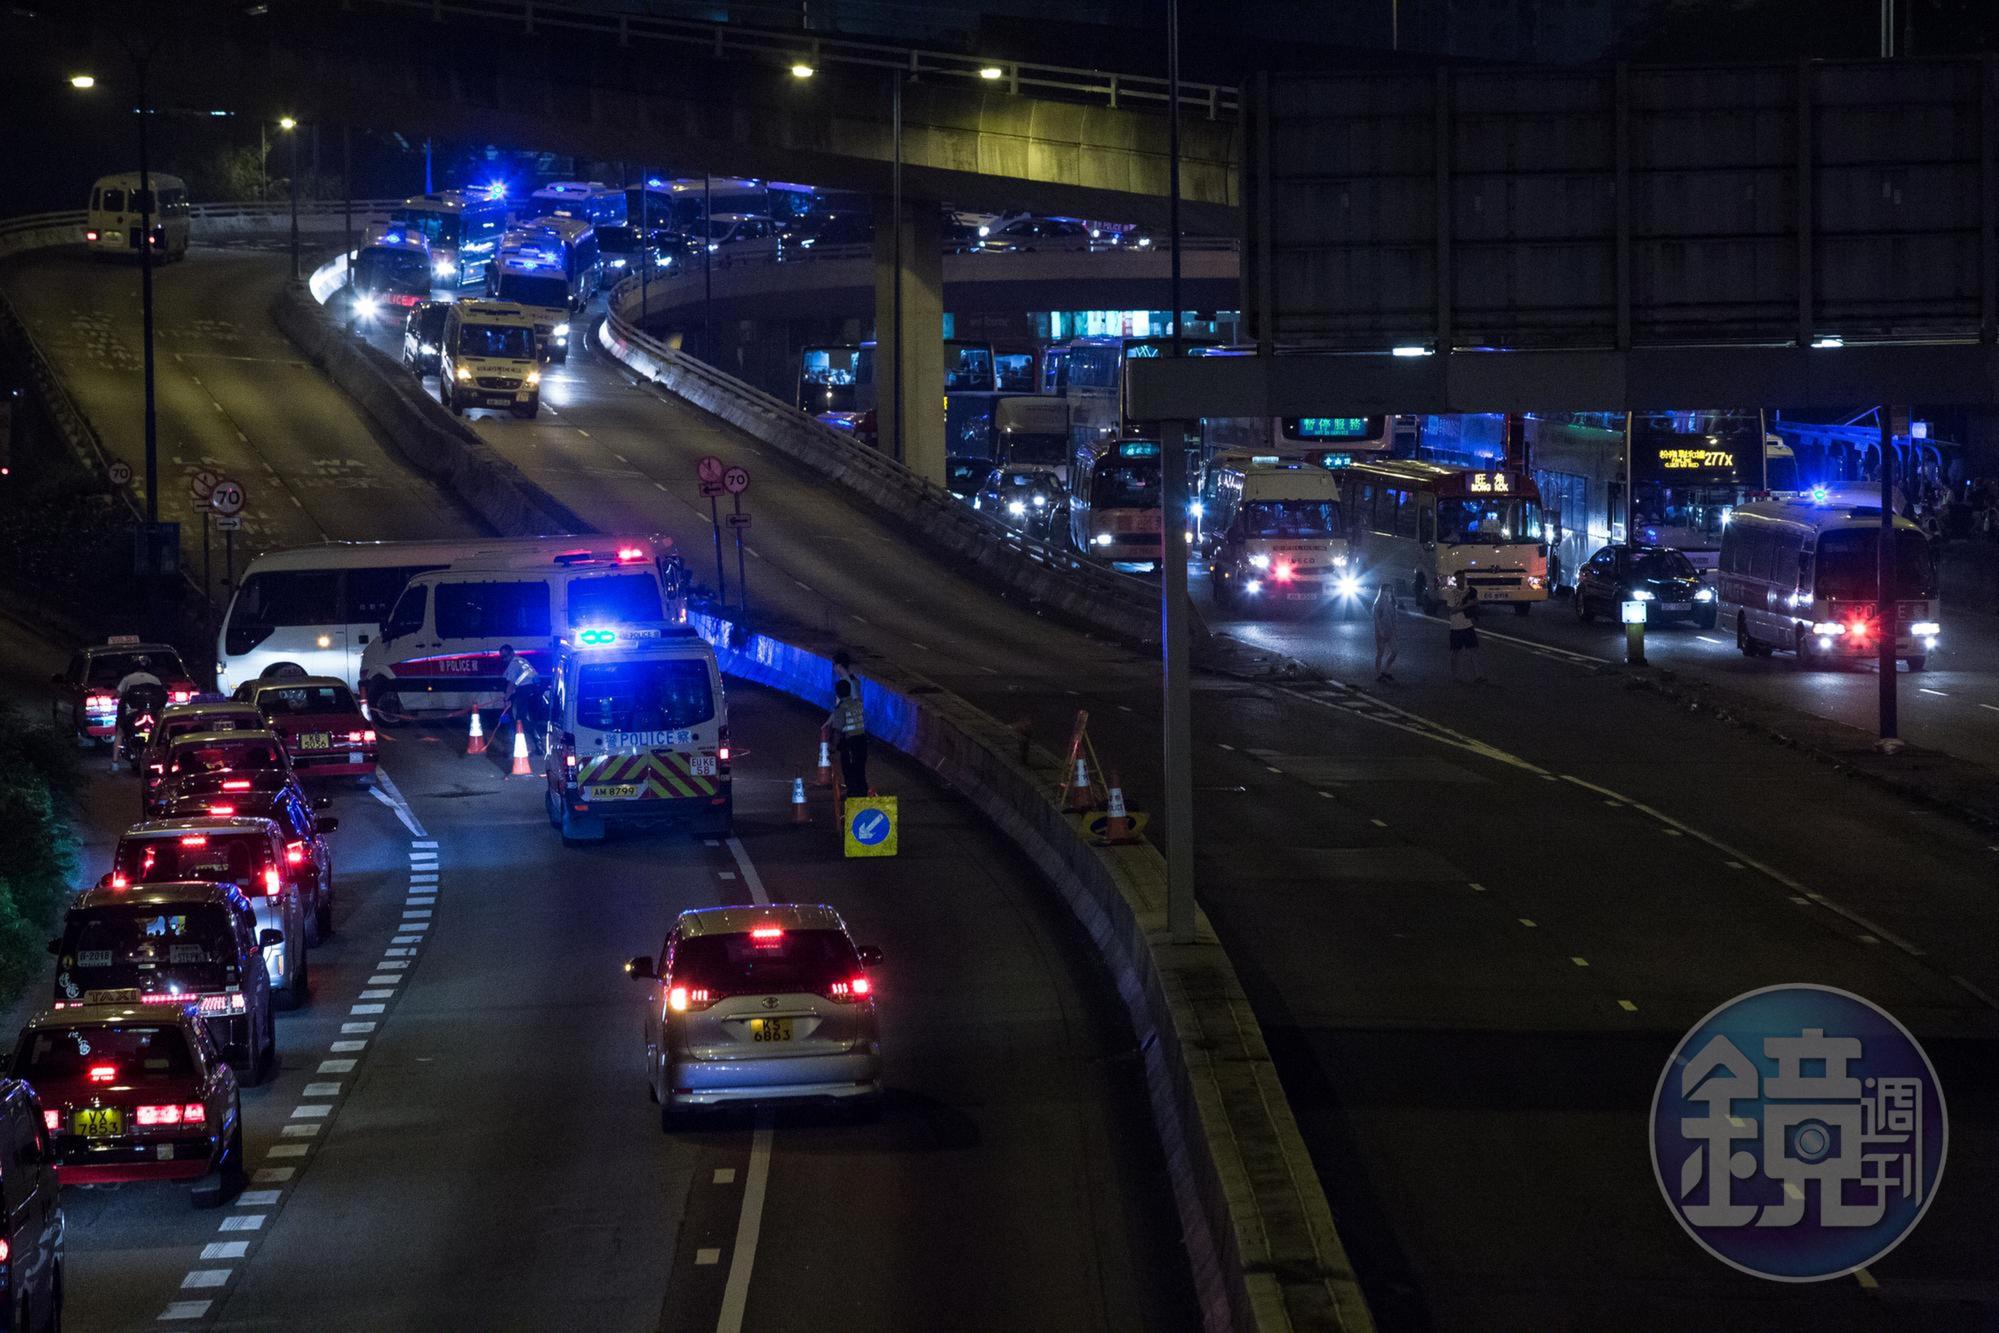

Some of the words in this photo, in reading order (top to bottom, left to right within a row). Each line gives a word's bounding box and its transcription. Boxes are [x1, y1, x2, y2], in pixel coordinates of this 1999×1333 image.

[112, 468, 128, 479] 70
[728, 475, 745, 485] 70
[1471, 483, 1492, 492] MONG
[1494, 483, 1509, 492] KOK
[216, 490, 239, 505] 70
[630, 631, 652, 639] POLICE
[446, 660, 471, 672] POLICE
[620, 732, 674, 747] POLICE
[697, 766, 710, 774] 58
[594, 788, 607, 796] AM
[609, 787, 635, 796] 8799
[88, 991, 136, 1002] TAXI
[754, 1030, 790, 1041] 6863
[89, 1111, 107, 1123] VX
[78, 1122, 118, 1135] 7853
